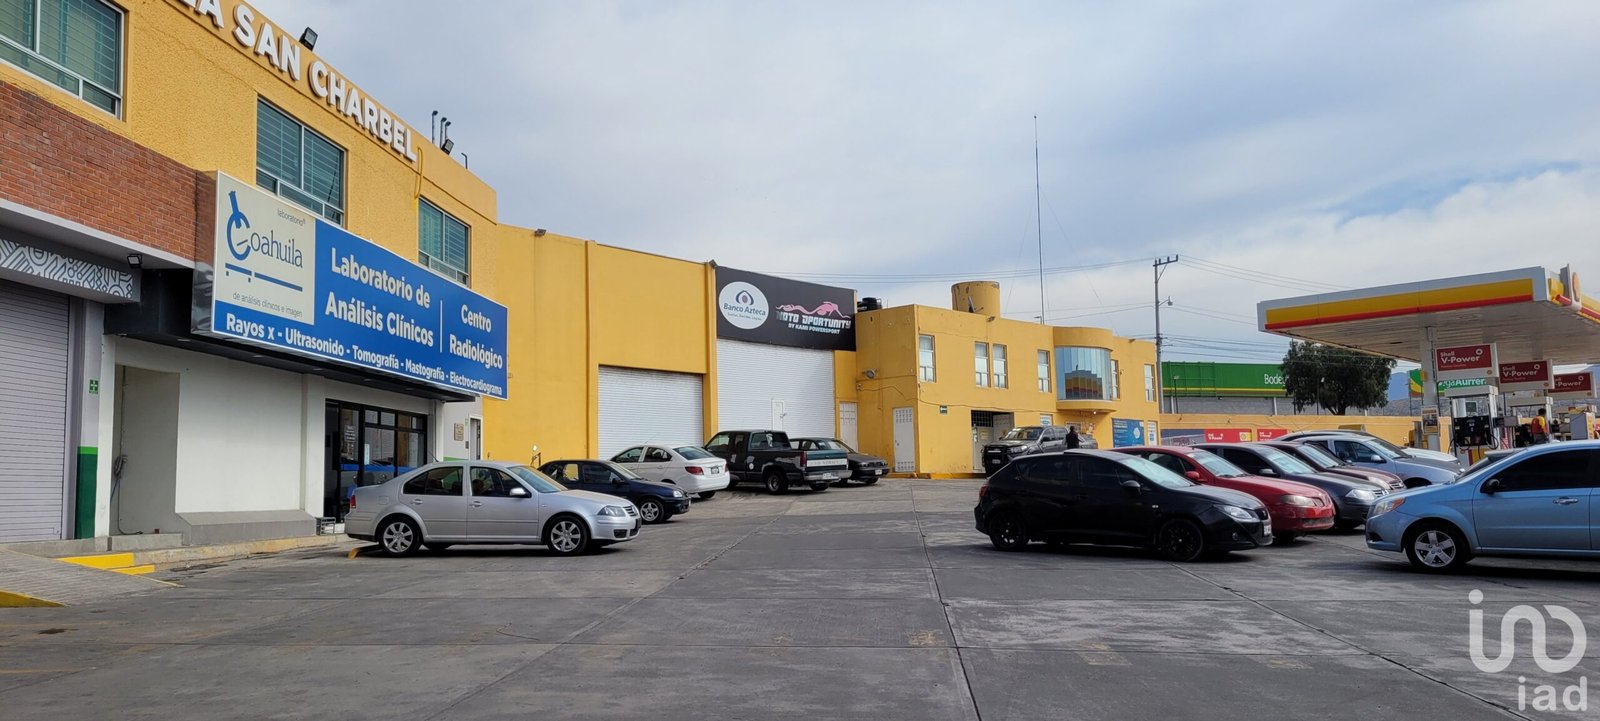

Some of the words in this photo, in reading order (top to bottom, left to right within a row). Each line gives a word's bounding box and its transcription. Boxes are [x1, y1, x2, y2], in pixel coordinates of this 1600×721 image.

[232, 4, 300, 81] SAN
[308, 60, 417, 163] CHARBEL
[331, 247, 413, 301] Laboratorio
[416, 285, 430, 309] de
[325, 291, 384, 331] Análisis
[386, 311, 434, 347] Clínicos
[461, 304, 492, 333] Centro
[723, 302, 743, 313] Banco
[744, 306, 766, 316] Azteca
[226, 312, 265, 337] Rayos
[285, 327, 344, 356] Ultrasonido
[352, 344, 399, 370] Tomografía
[405, 359, 445, 381] Mastografía
[450, 371, 502, 396] Electrocardiograma
[449, 334, 503, 369] Radiológico
